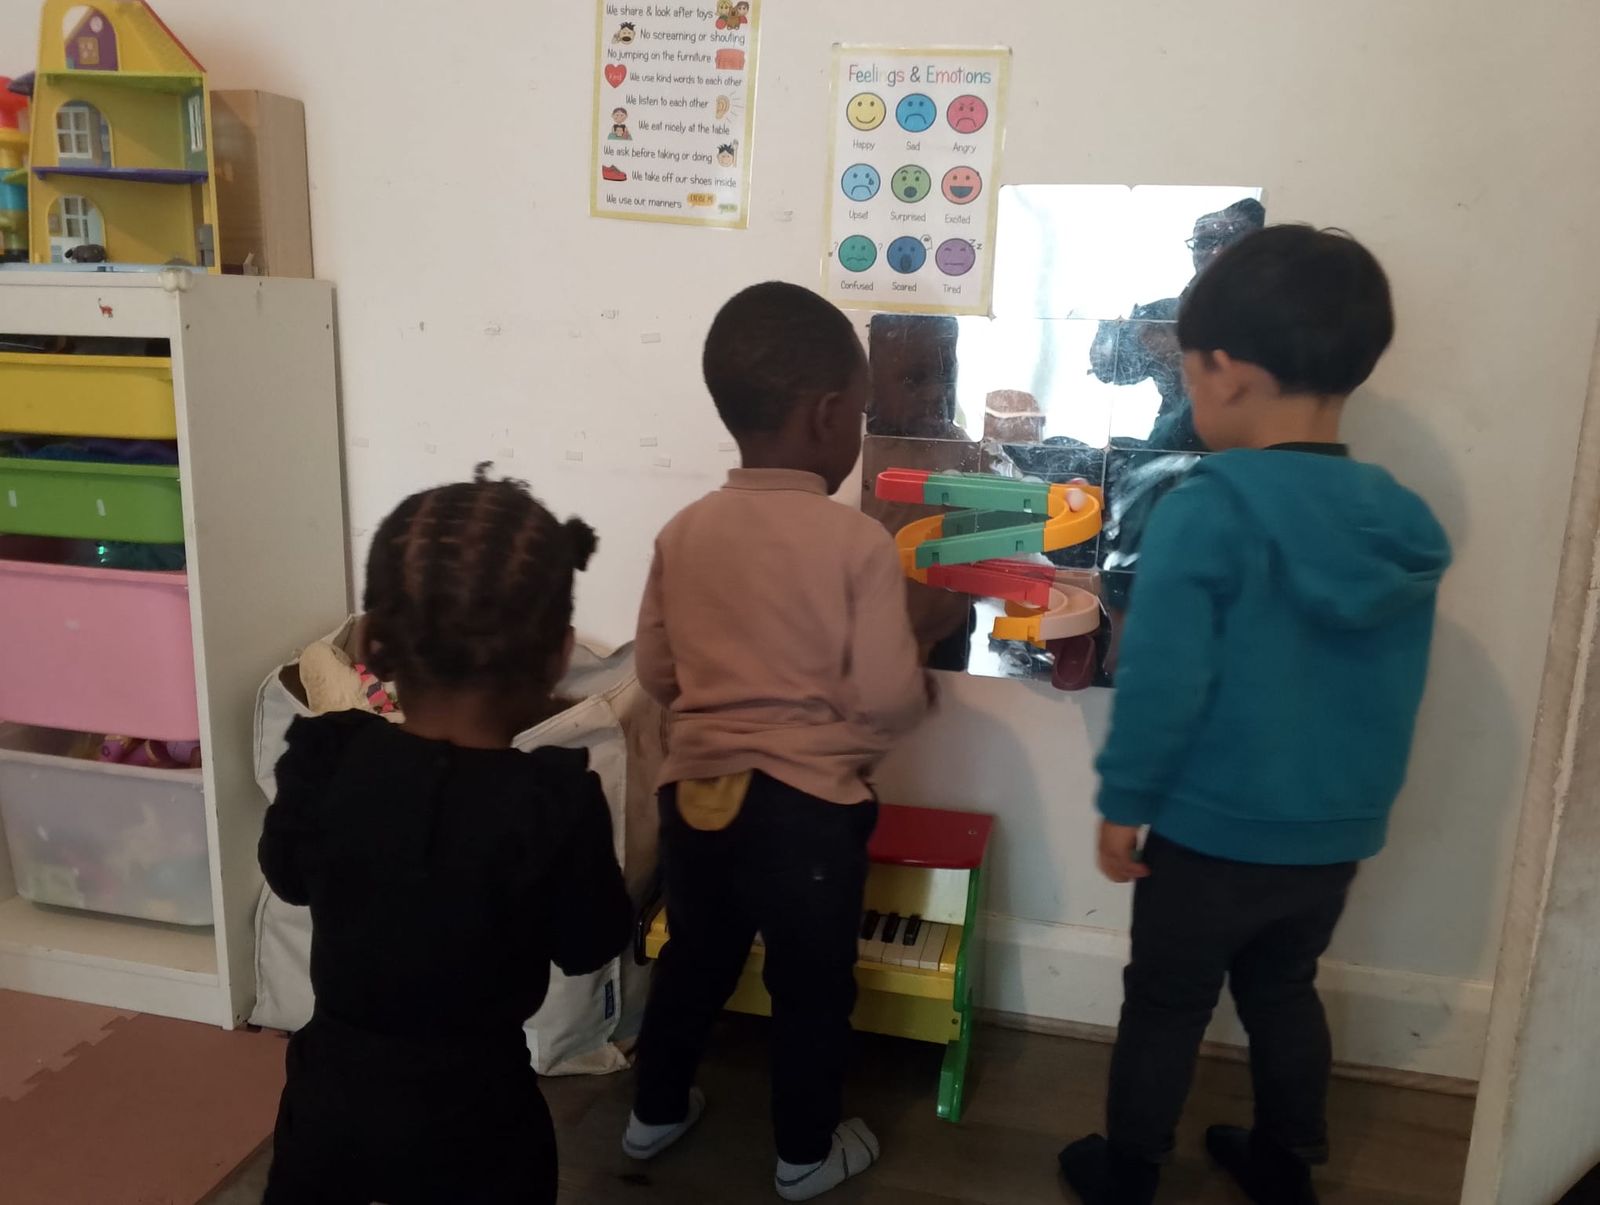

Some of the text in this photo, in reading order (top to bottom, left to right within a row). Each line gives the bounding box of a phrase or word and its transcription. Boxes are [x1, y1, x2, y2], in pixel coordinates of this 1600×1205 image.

[607, 5, 713, 22] We share & look after toys
[640, 29, 650, 40] No
[652, 30, 696, 43] screaming
[710, 31, 745, 45] shouting
[607, 49, 711, 62] No jumping on the furniture
[630, 71, 640, 81] We
[656, 71, 671, 83] kind
[674, 73, 695, 84] words
[697, 74, 703, 84] to
[705, 74, 722, 85] each
[724, 75, 742, 86] other
[849, 64, 991, 87] Feeligs & Emotions
[626, 95, 708, 108] We listen to each other
[639, 120, 730, 135] We eat nicely at the table
[853, 139, 875, 150] Happy
[906, 141, 920, 150] Sad
[953, 142, 976, 153] Angry
[604, 145, 712, 164] We ask before taking or doing
[632, 171, 642, 181] We
[645, 172, 660, 181] take
[662, 173, 674, 182] off
[690, 174, 712, 185] shoes
[714, 176, 736, 187] inside
[606, 194, 617, 204] We
[619, 196, 631, 205] use
[649, 199, 682, 208] manners
[849, 210, 868, 220] Upset
[890, 212, 926, 222] Surprised
[945, 214, 971, 224] Excited
[841, 281, 873, 290] Confused
[892, 281, 917, 292] Scared
[943, 284, 961, 293] Tired
